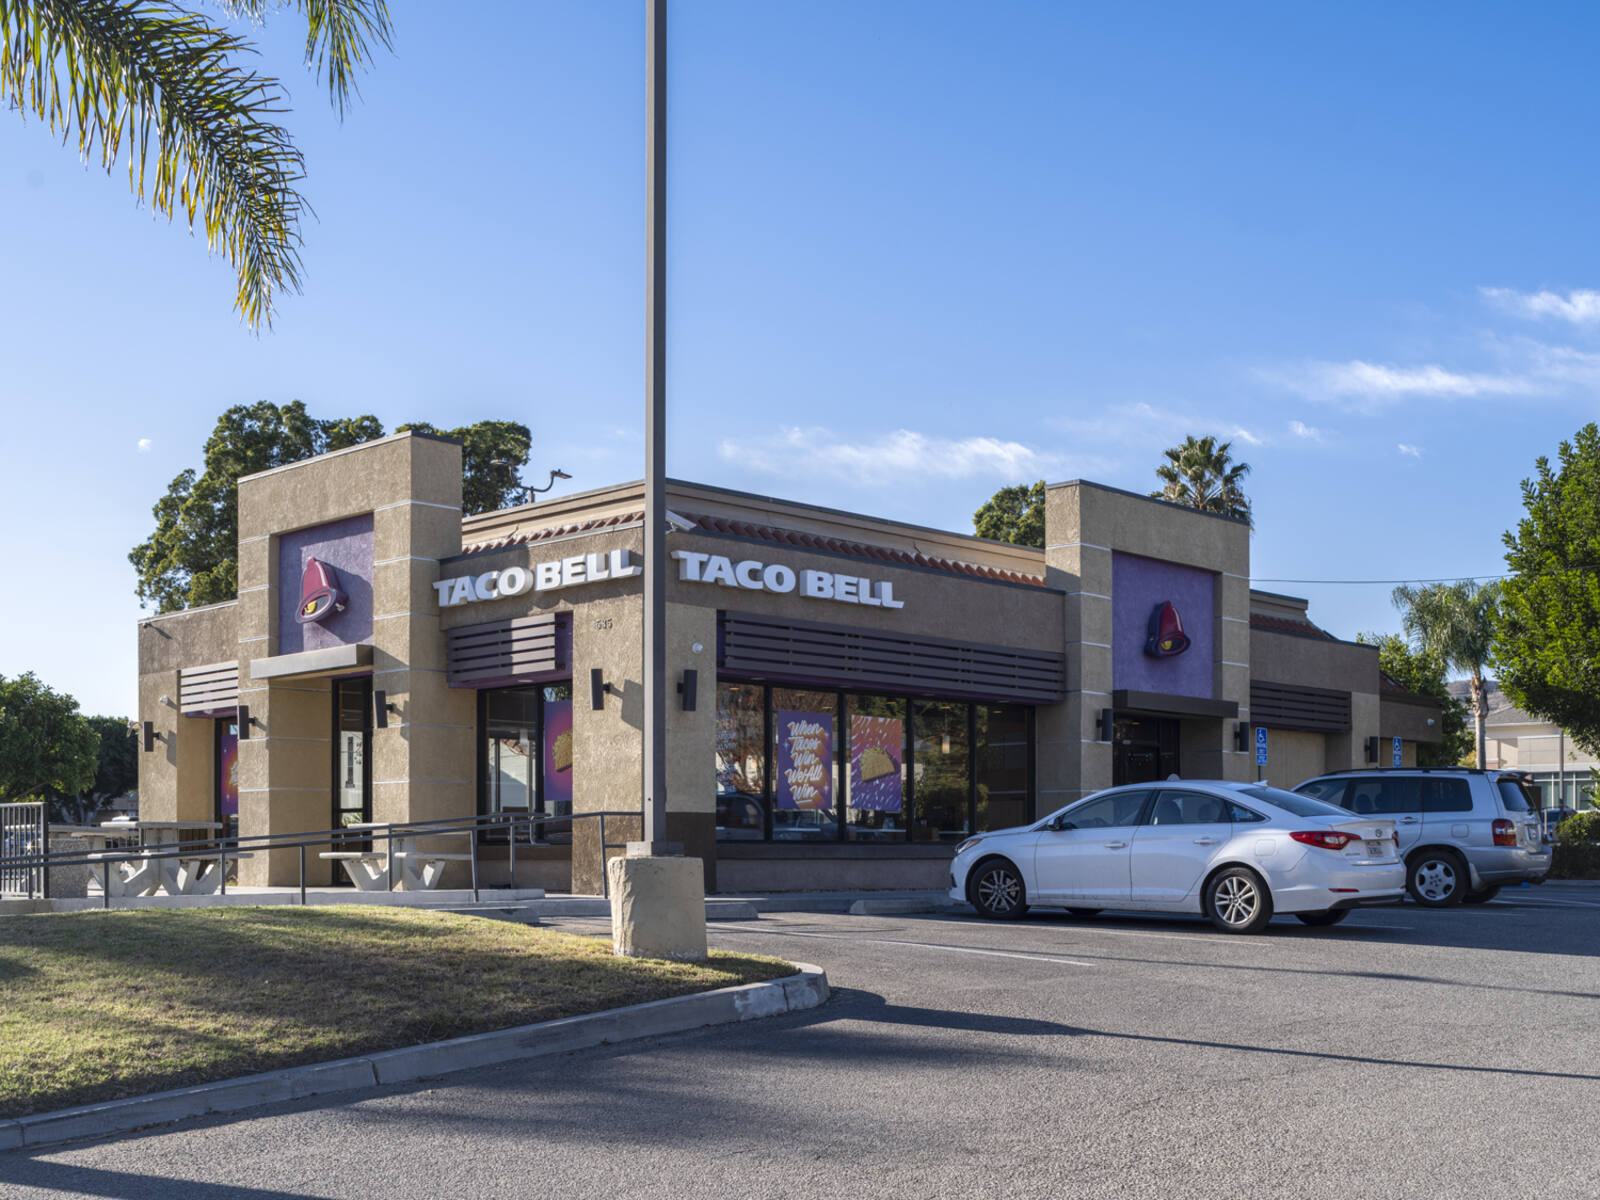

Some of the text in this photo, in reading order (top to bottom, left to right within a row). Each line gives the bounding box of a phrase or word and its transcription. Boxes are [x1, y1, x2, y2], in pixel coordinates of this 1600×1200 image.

[432, 549, 643, 607] TACO BELL
[671, 550, 905, 609] TACO BELL
[787, 720, 824, 736] When
[790, 750, 819, 767] Win
[789, 783, 818, 801] Win
